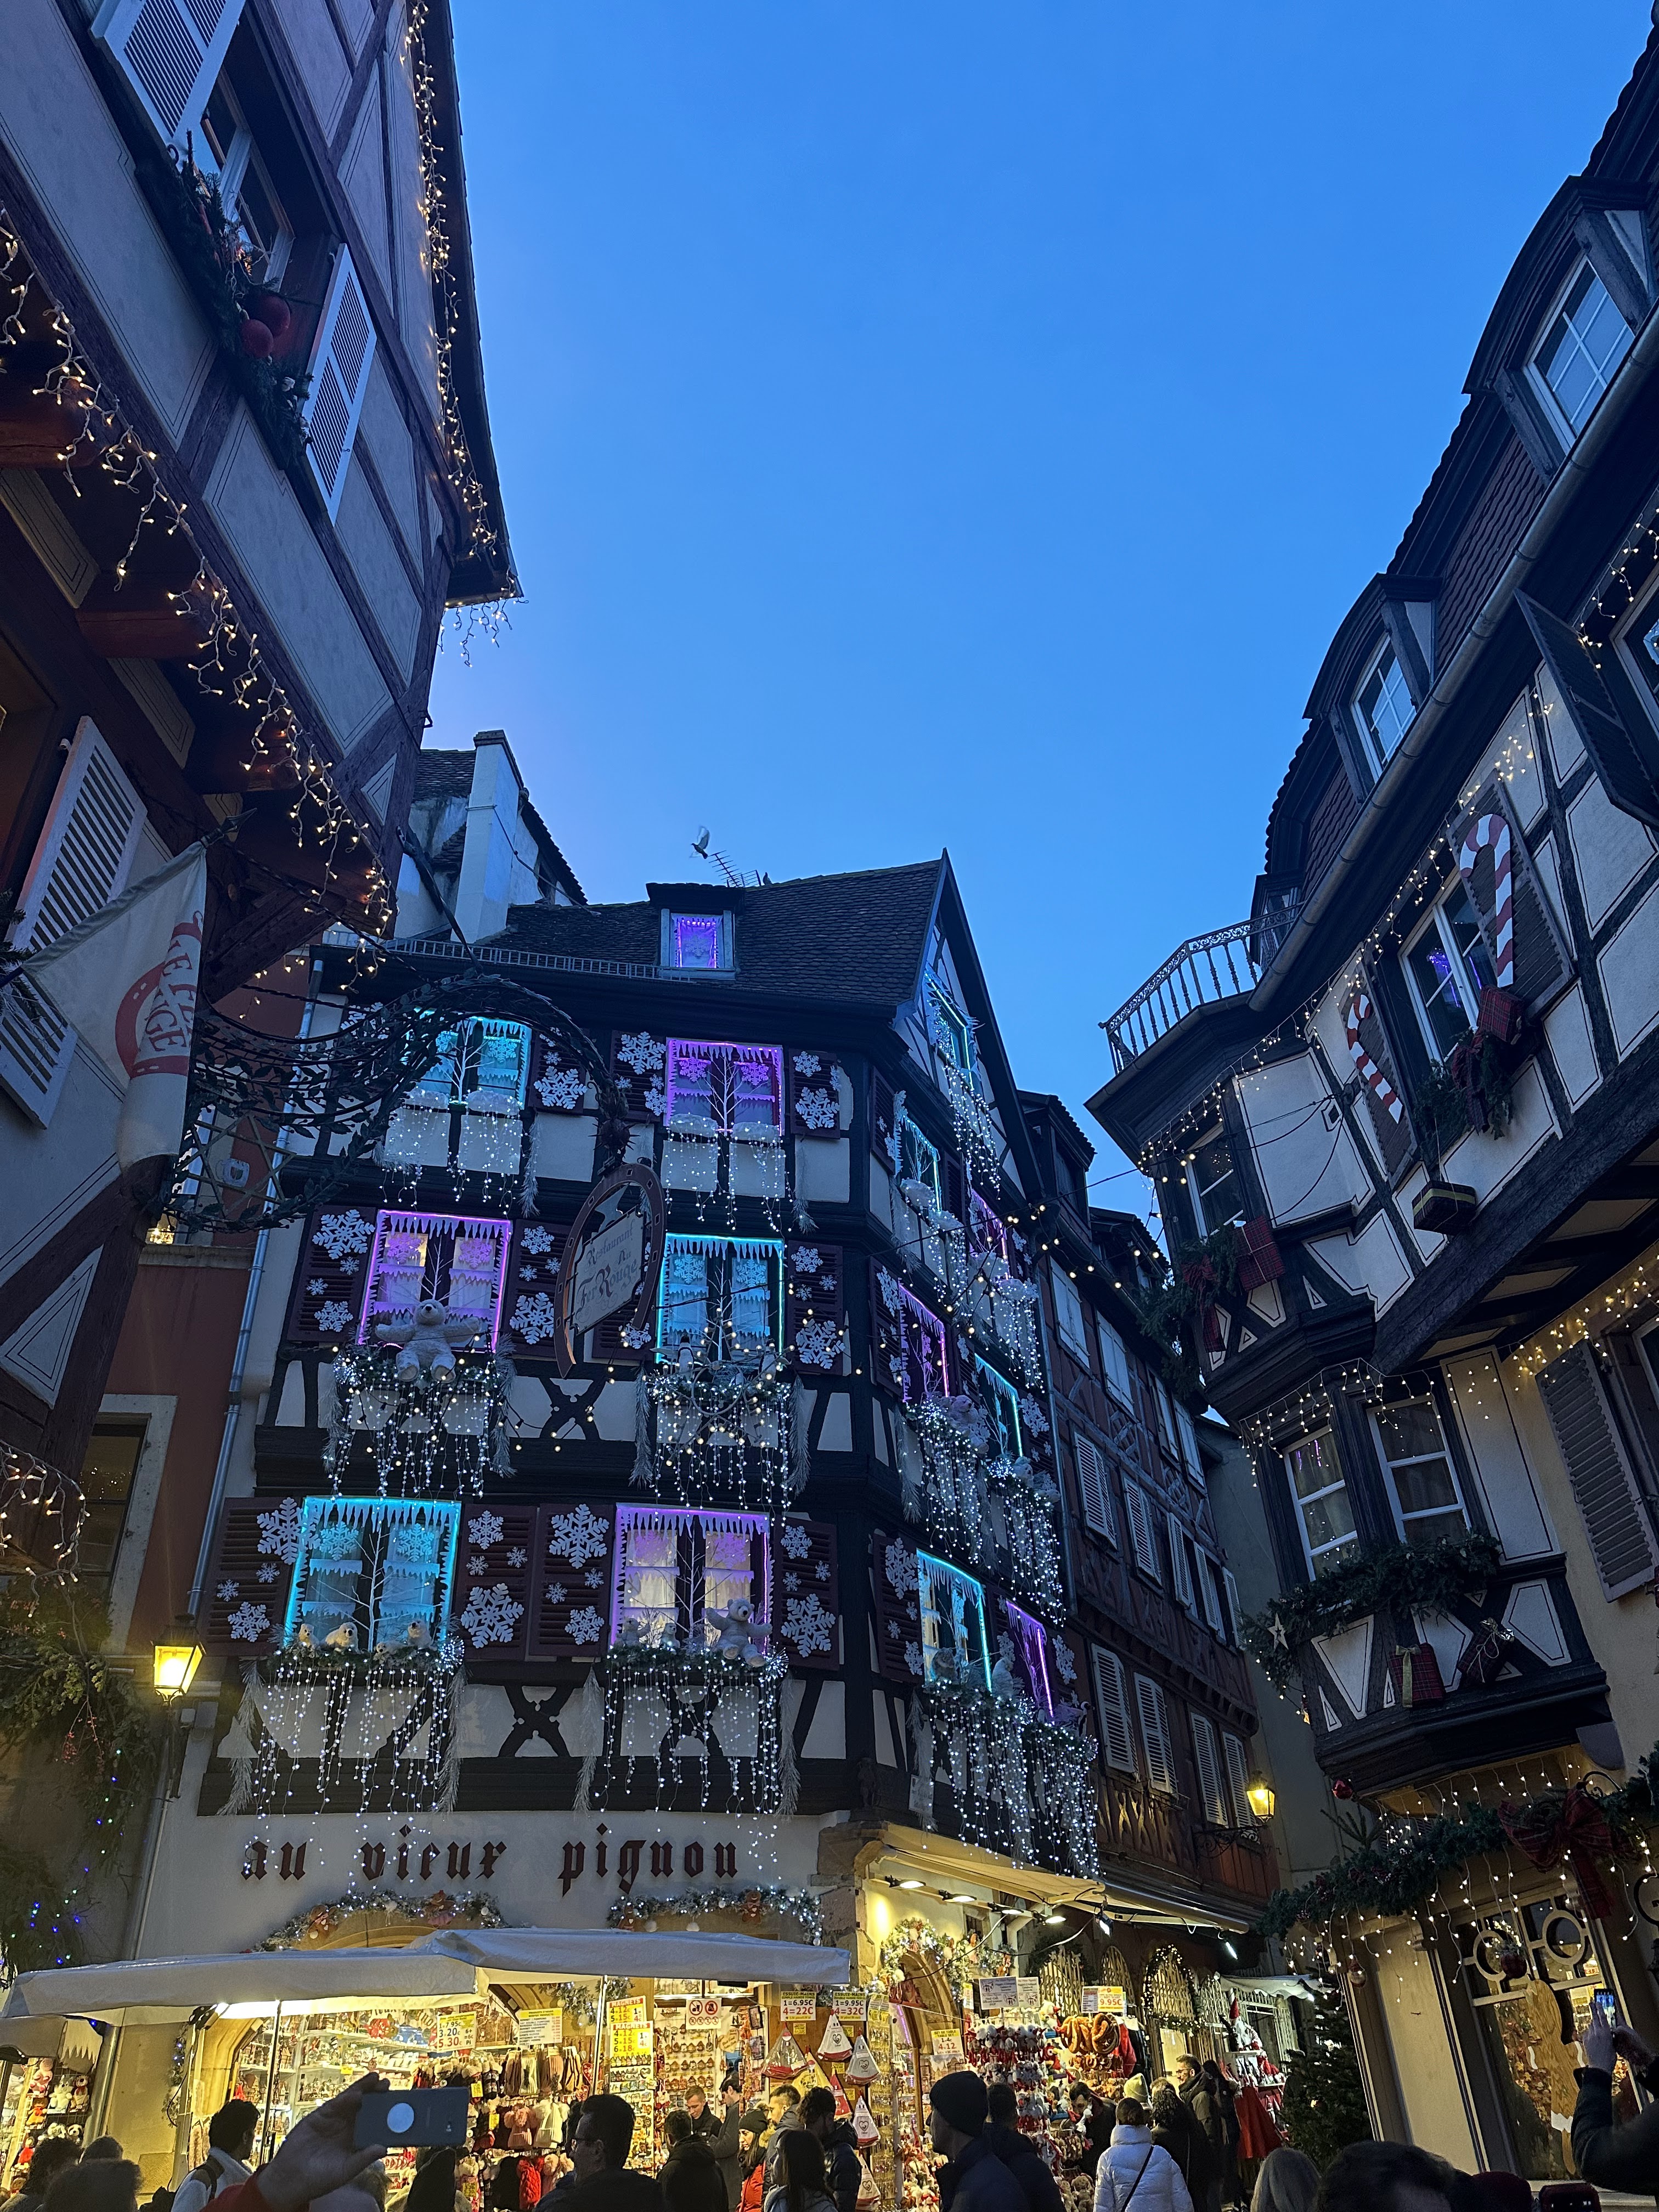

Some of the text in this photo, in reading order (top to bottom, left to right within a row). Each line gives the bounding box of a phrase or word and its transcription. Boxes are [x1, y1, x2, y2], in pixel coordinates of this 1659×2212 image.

[586, 1218, 636, 1267] Restaurant
[618, 1248, 631, 1266] Au
[576, 1259, 639, 1317] Fer Rouge
[241, 1822, 738, 1898] au vieux pignon
[611, 1999, 641, 2007] MAGNETS
